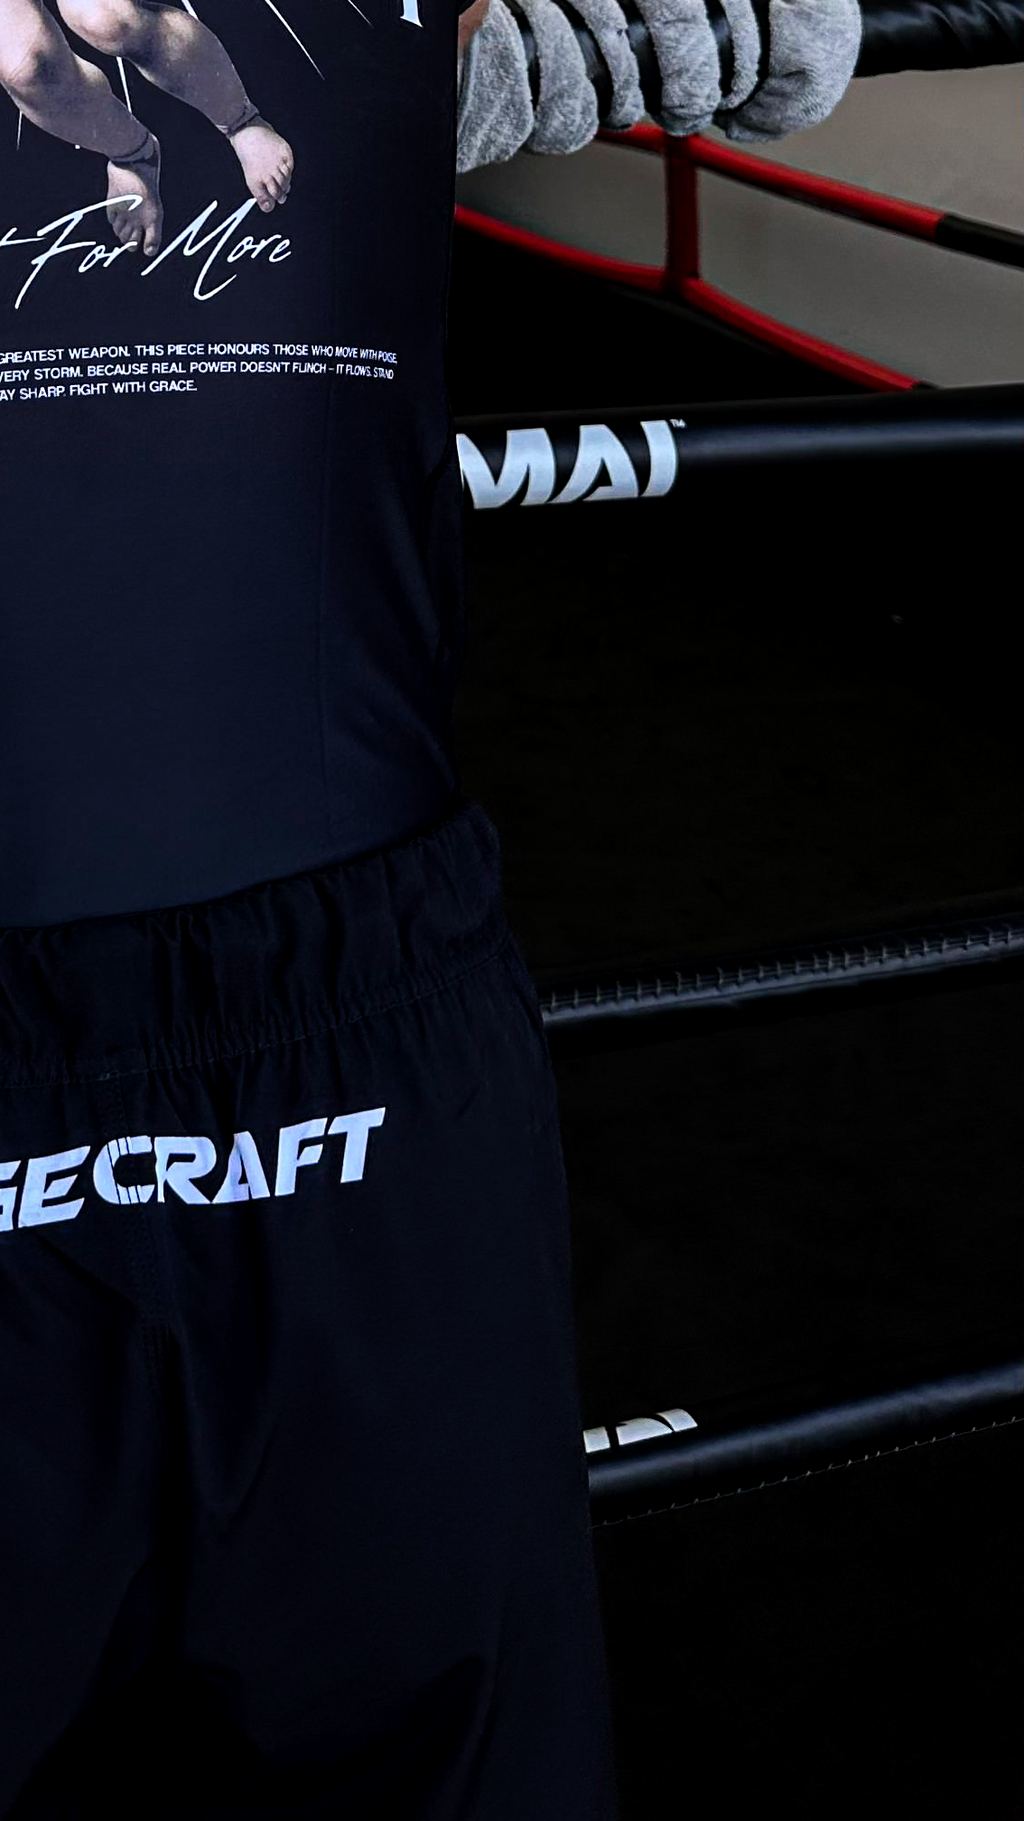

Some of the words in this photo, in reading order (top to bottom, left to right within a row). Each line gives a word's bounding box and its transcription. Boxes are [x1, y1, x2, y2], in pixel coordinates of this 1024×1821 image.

[13, 193, 144, 310] For
[140, 197, 293, 302] More
[134, 344, 165, 356] THIS
[167, 344, 205, 356] PIECE
[208, 343, 270, 356] HONOURS
[273, 344, 309, 356] THOSE
[311, 345, 334, 357] WHO
[335, 346, 358, 359] MOVE
[360, 348, 378, 361] WITH
[87, 363, 149, 377] BECAUSE
[151, 362, 187, 374] REAL
[189, 361, 237, 373] POWER
[292, 362, 327, 375] FLINCH
[336, 364, 345, 375] IT
[373, 367, 395, 380] STAND
[70, 383, 108, 397] FIGHT
[112, 380, 147, 394] WITH
